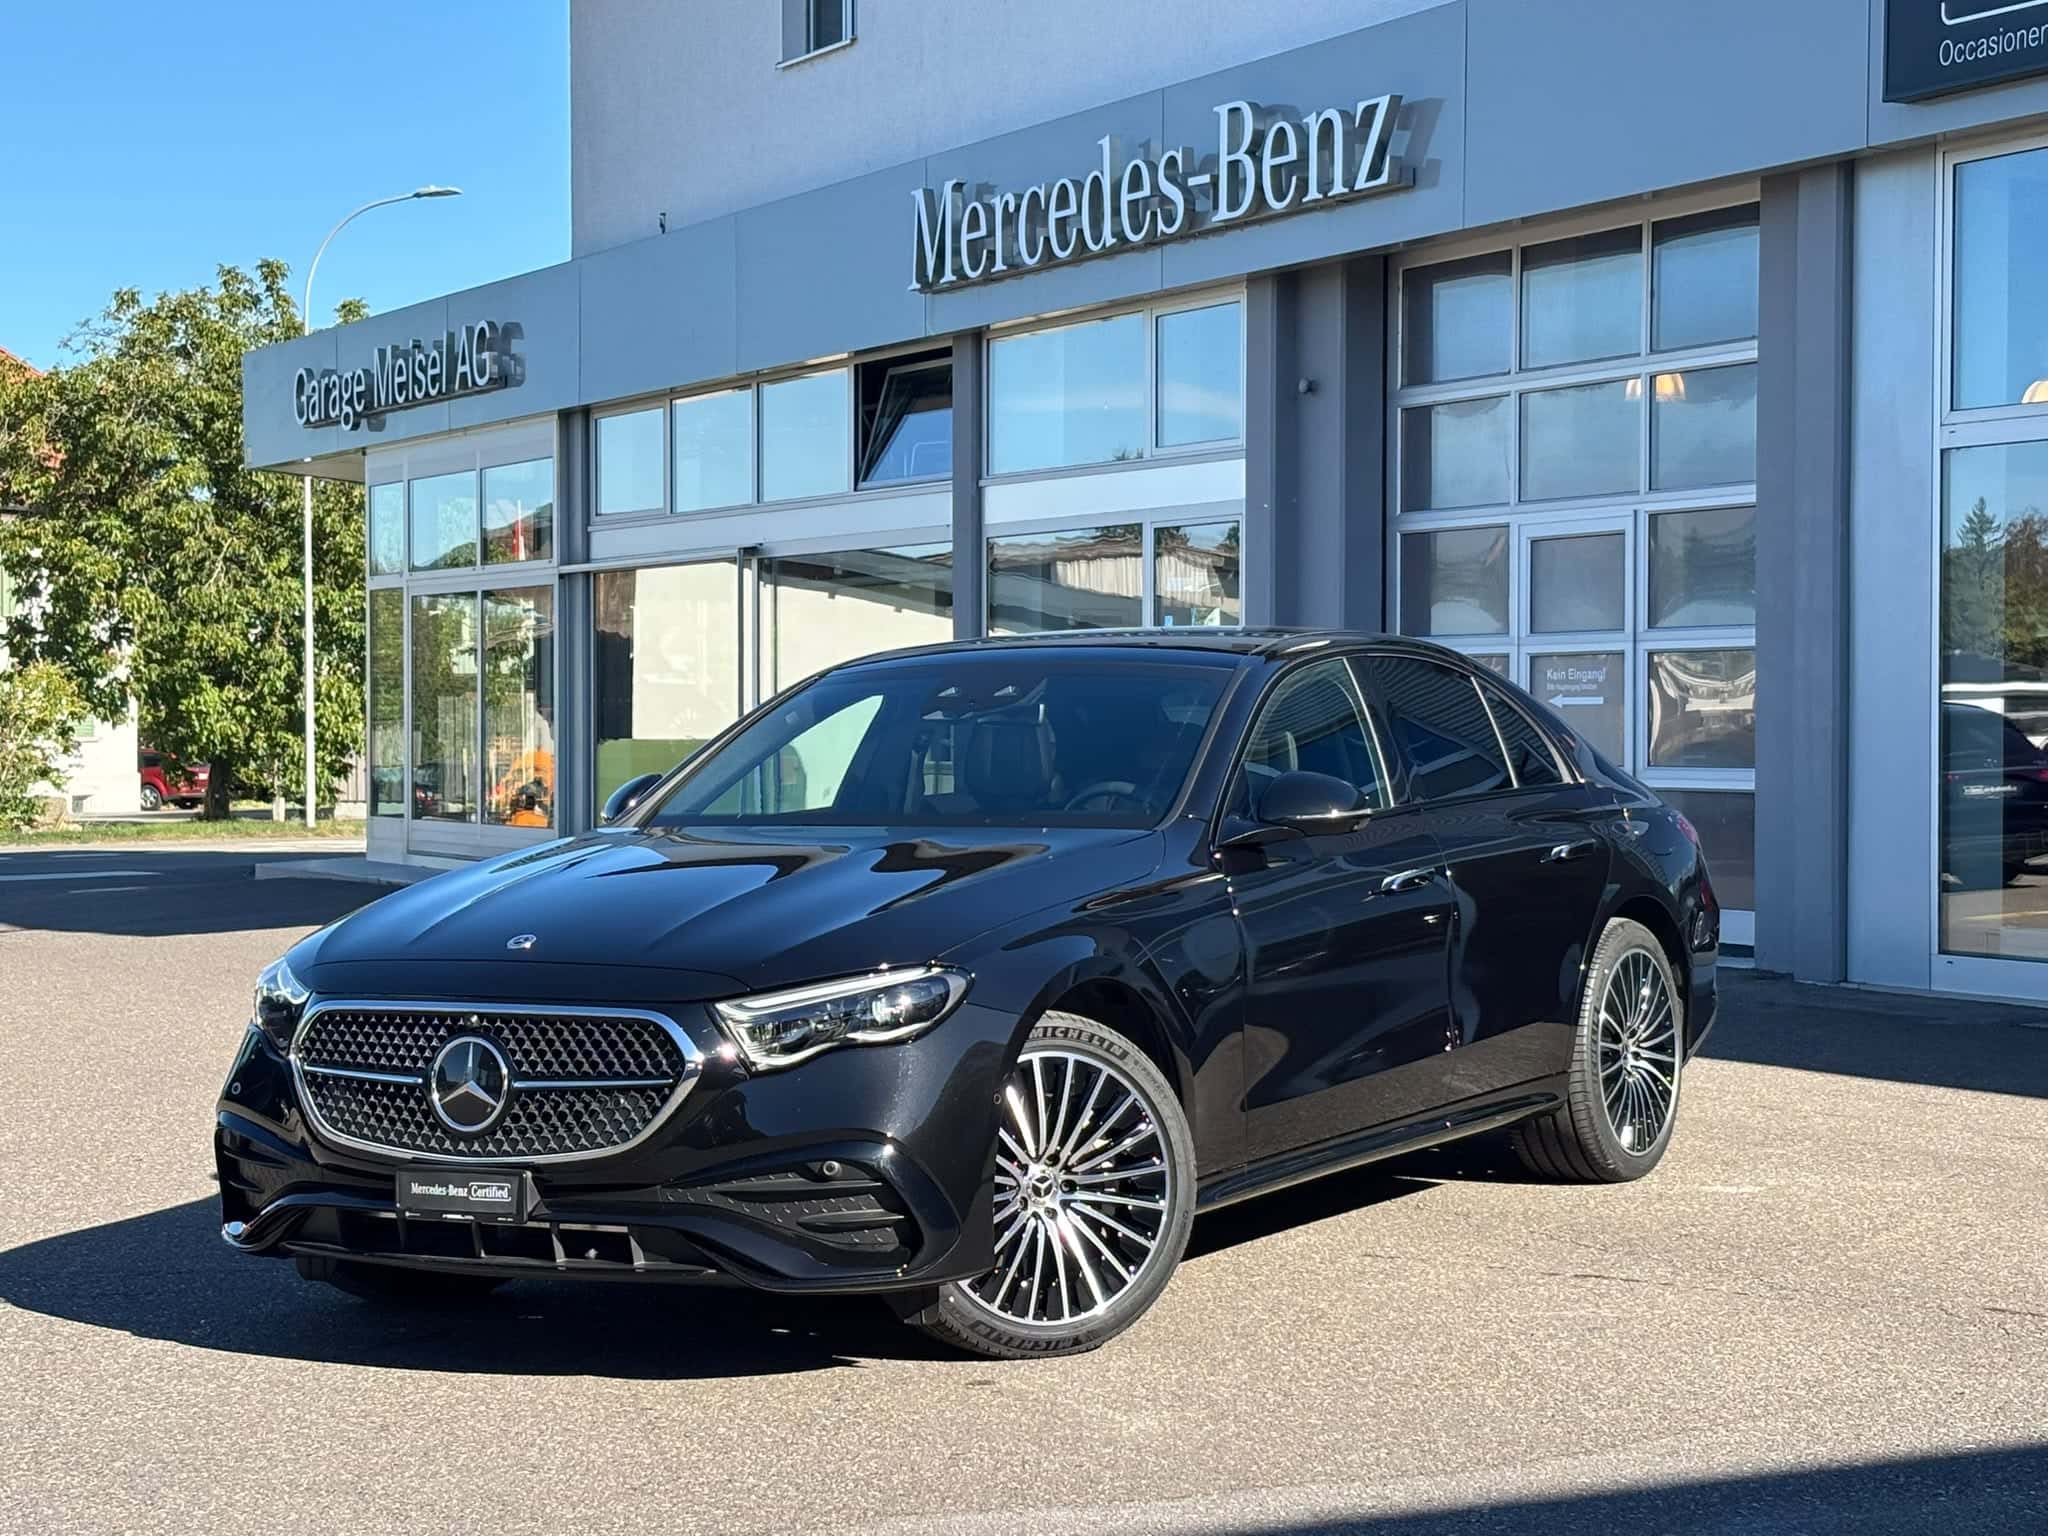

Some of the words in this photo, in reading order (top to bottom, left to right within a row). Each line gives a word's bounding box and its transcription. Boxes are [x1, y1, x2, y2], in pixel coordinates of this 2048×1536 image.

[908, 94, 1404, 292] Mercedes-Benz
[294, 367, 366, 431] Garage
[373, 330, 449, 408] Meisel
[454, 319, 491, 391] AG
[1546, 668, 1566, 681] Kein
[1028, 1026, 1124, 1057] MICHELIN
[410, 1182, 468, 1197] Mercedes-Benz
[471, 1185, 509, 1199] Certified
